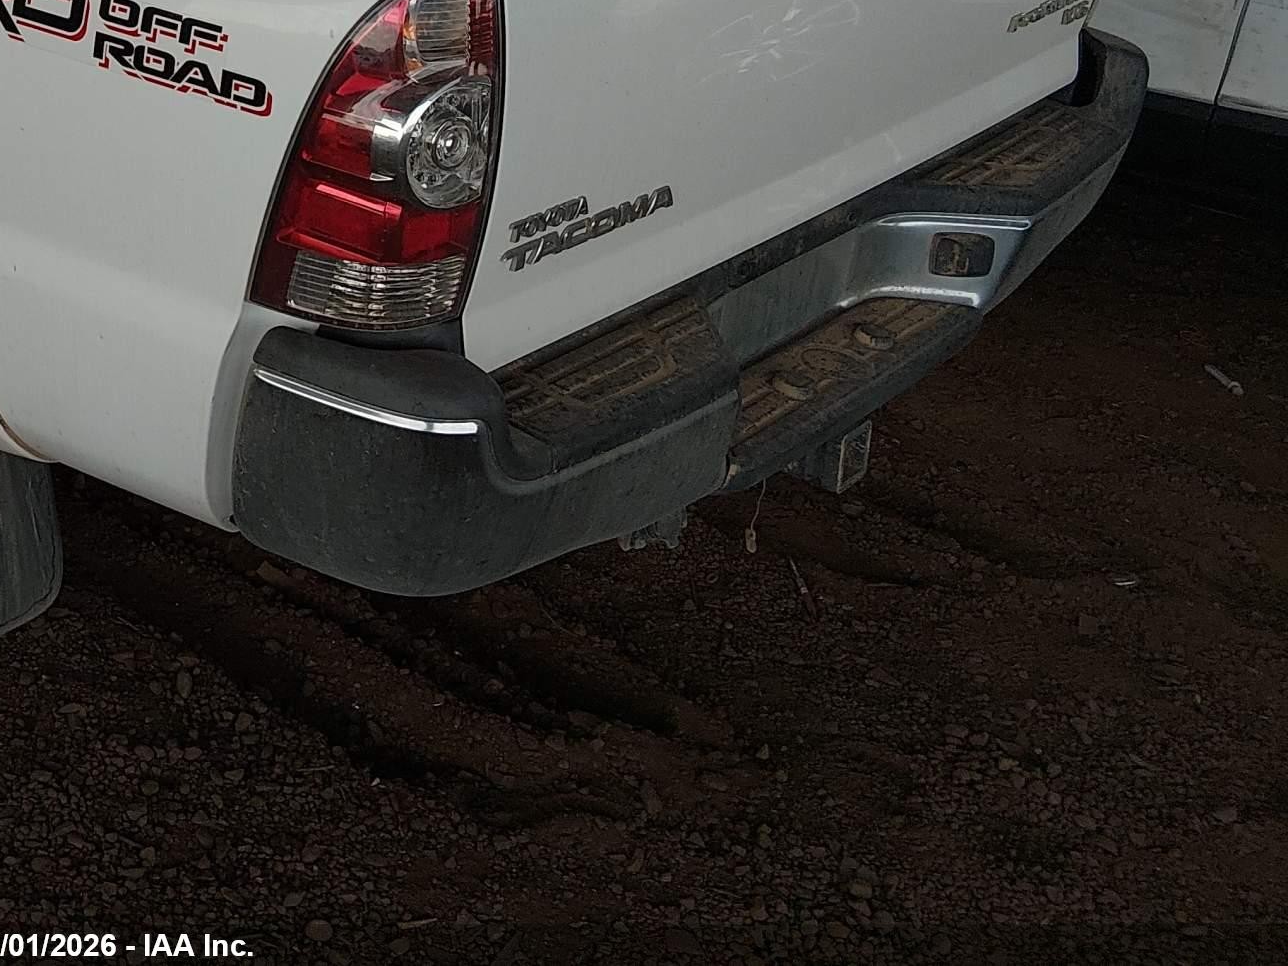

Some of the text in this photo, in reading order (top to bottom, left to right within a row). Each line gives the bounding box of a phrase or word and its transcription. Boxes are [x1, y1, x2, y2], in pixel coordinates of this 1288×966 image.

[93, 31, 273, 117] ROAD
[500, 185, 674, 272] TACOMA
[509, 195, 589, 243] TOYOTA
